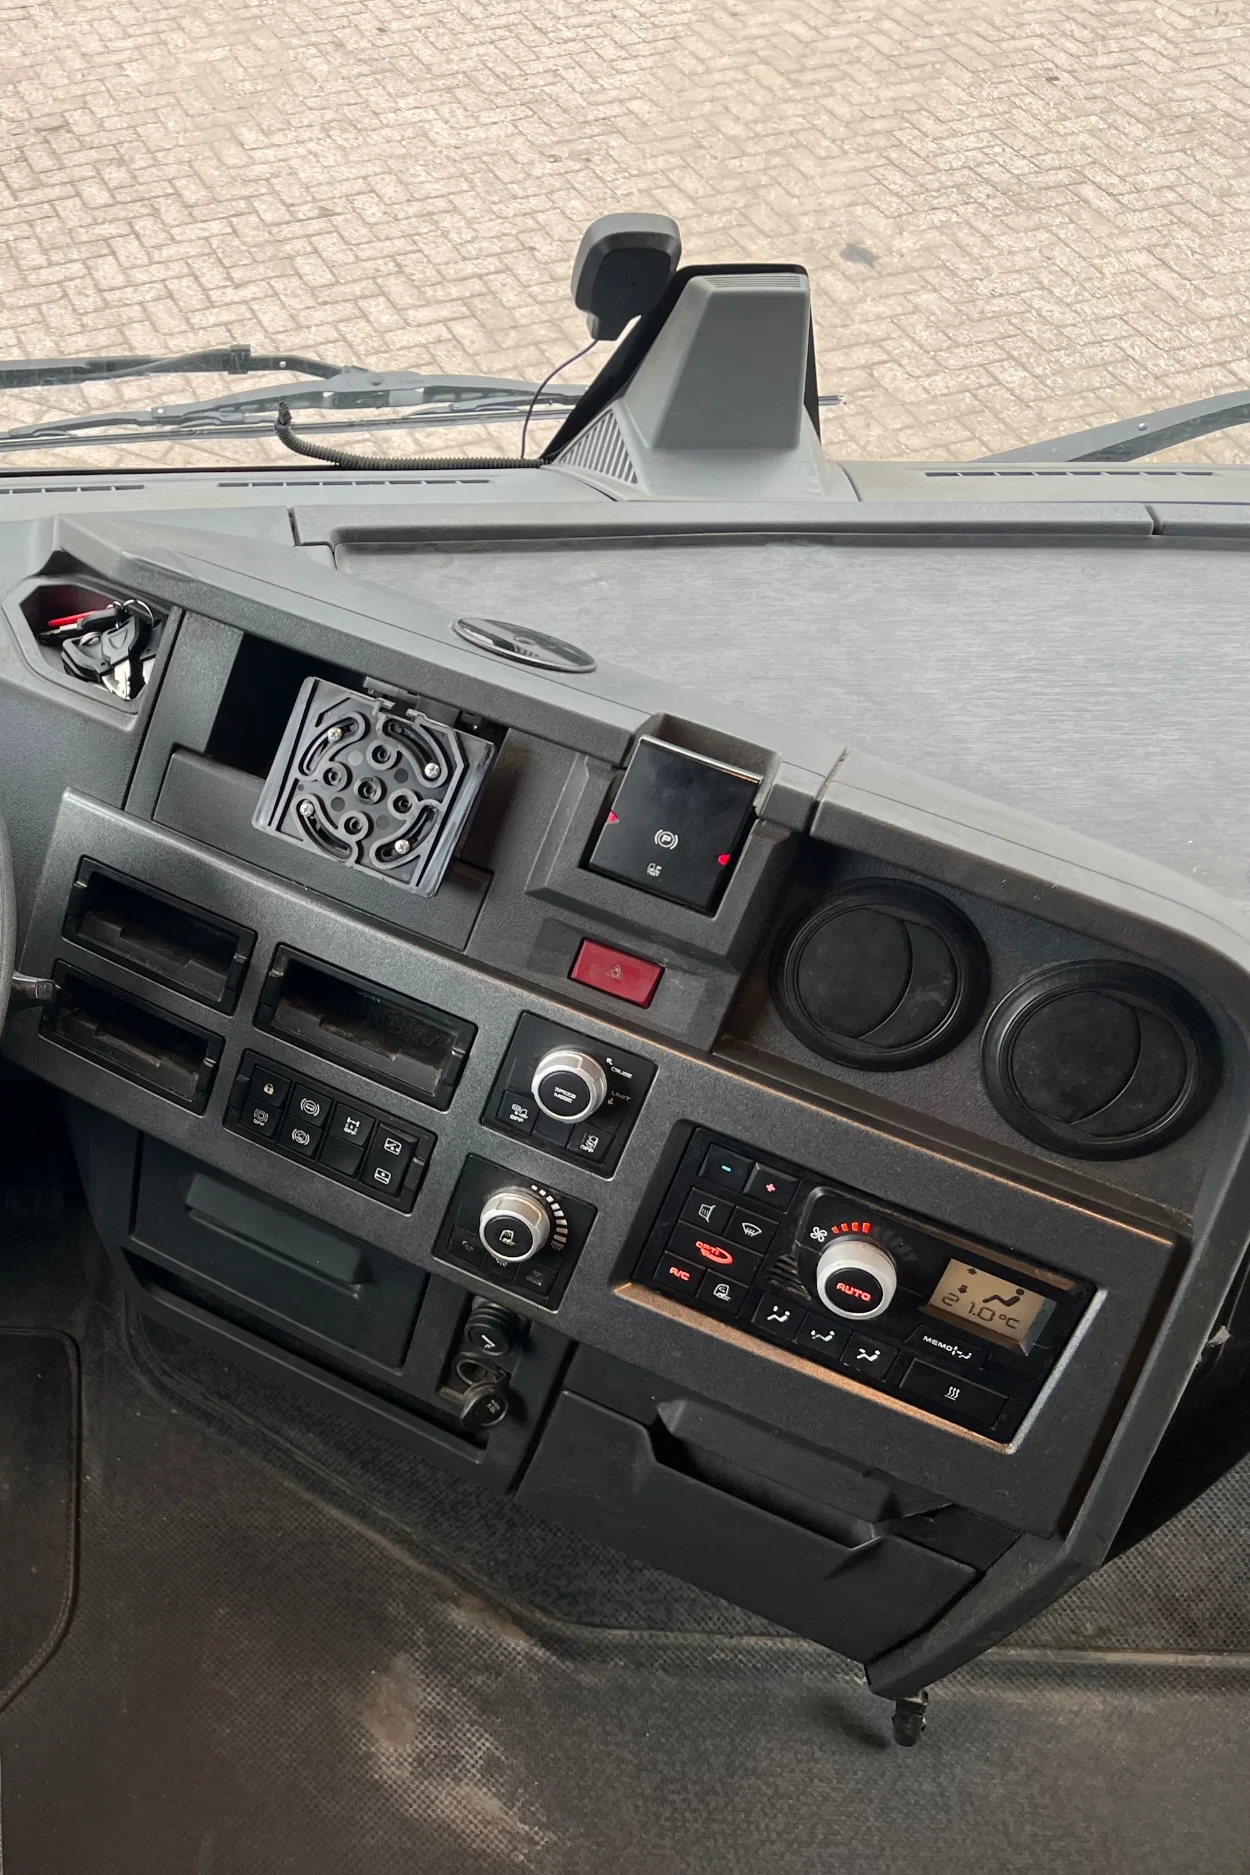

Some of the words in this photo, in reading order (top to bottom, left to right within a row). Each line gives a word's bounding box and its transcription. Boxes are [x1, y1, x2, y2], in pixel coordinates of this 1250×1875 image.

[610, 1066, 633, 1080] CRUISE
[611, 1090, 632, 1102] LIMIT
[669, 1266, 691, 1281] A/C
[836, 1281, 872, 1302] AUTO
[922, 1335, 954, 1352] MEMO
